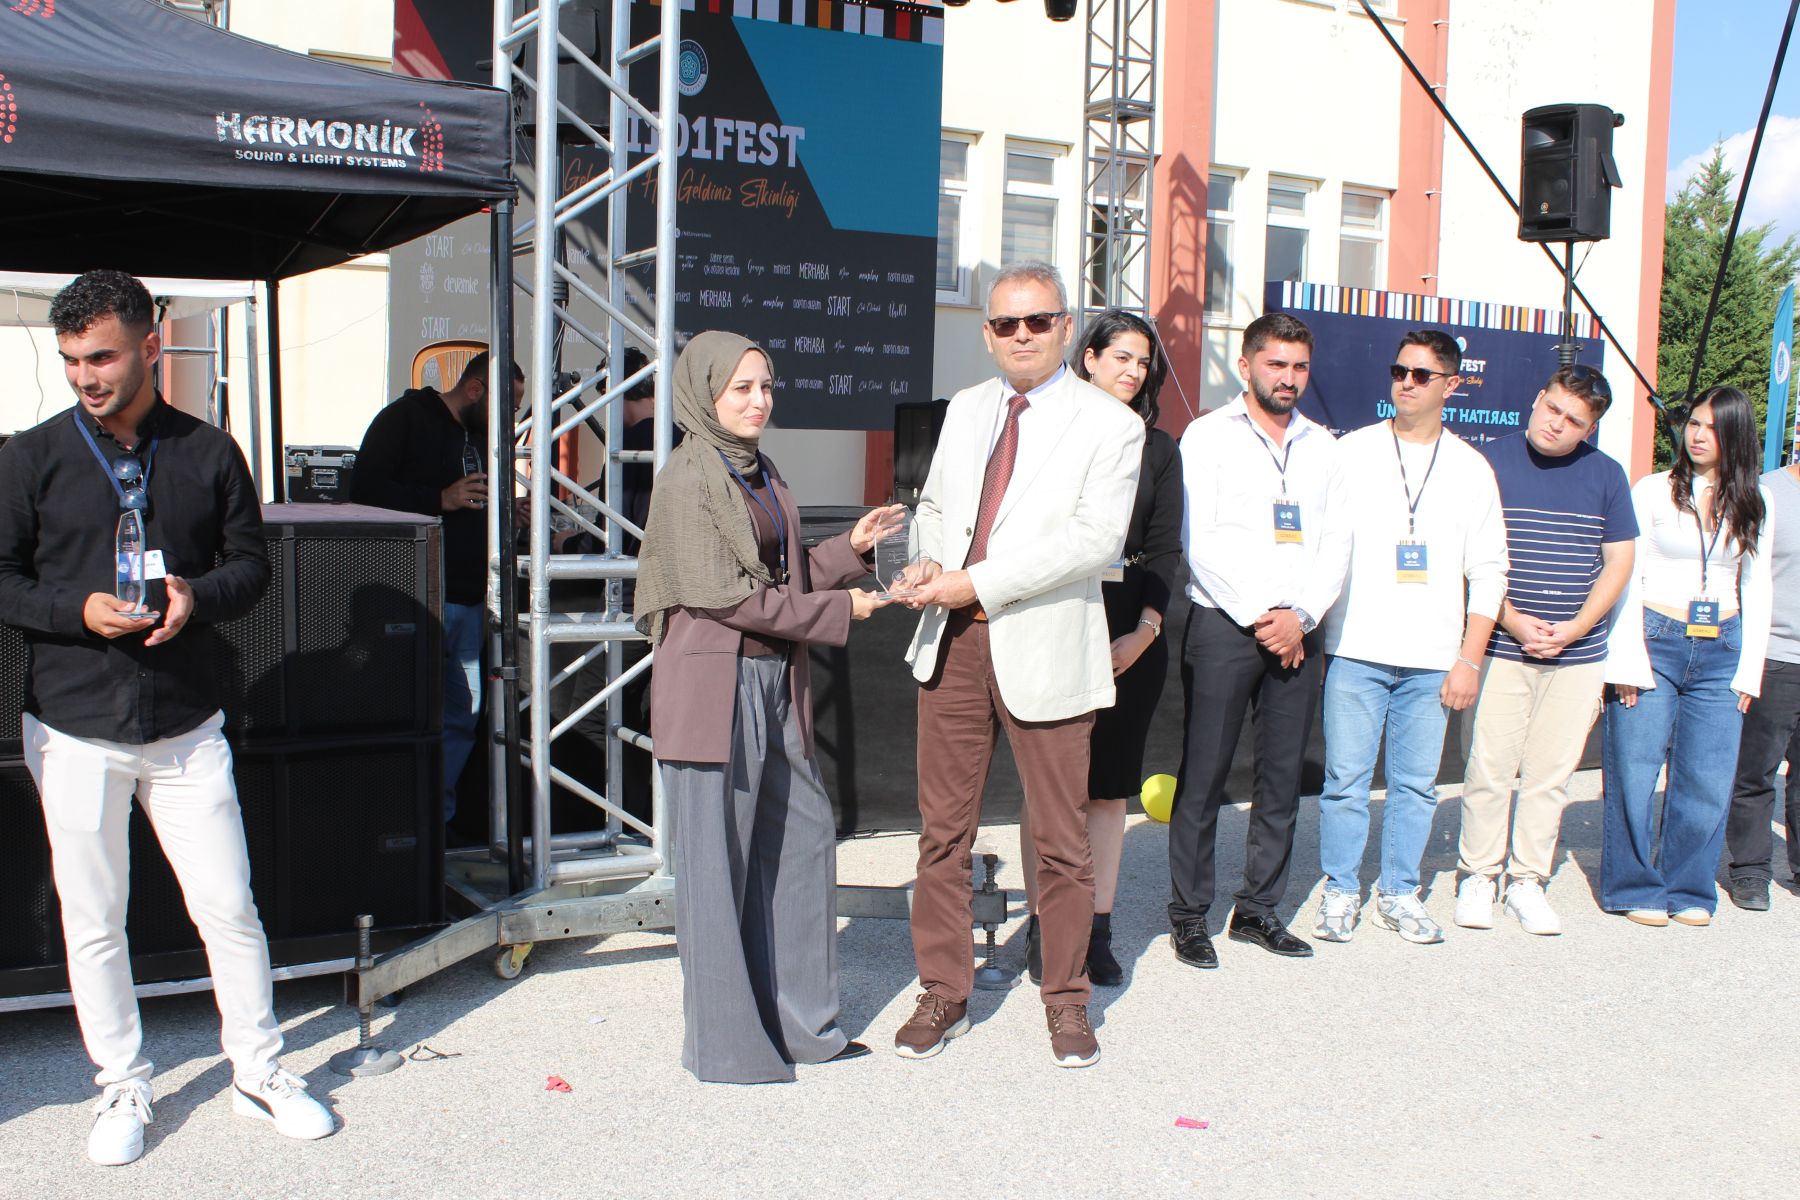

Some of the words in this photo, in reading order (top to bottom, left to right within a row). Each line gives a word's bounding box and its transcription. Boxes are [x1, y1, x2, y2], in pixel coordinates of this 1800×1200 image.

[235, 150, 284, 162] SOUND
[287, 154, 298, 163] &
[301, 154, 342, 165] LIGHT
[346, 157, 407, 169] SYSTEMS
[678, 168, 732, 203] Geldiniz
[425, 235, 455, 259] START
[799, 262, 830, 281] MERHABA
[700, 289, 732, 308] MERHABA
[827, 296, 851, 317] START
[421, 316, 450, 339] START
[794, 336, 825, 354] MERHABA
[829, 375, 853, 395] START
